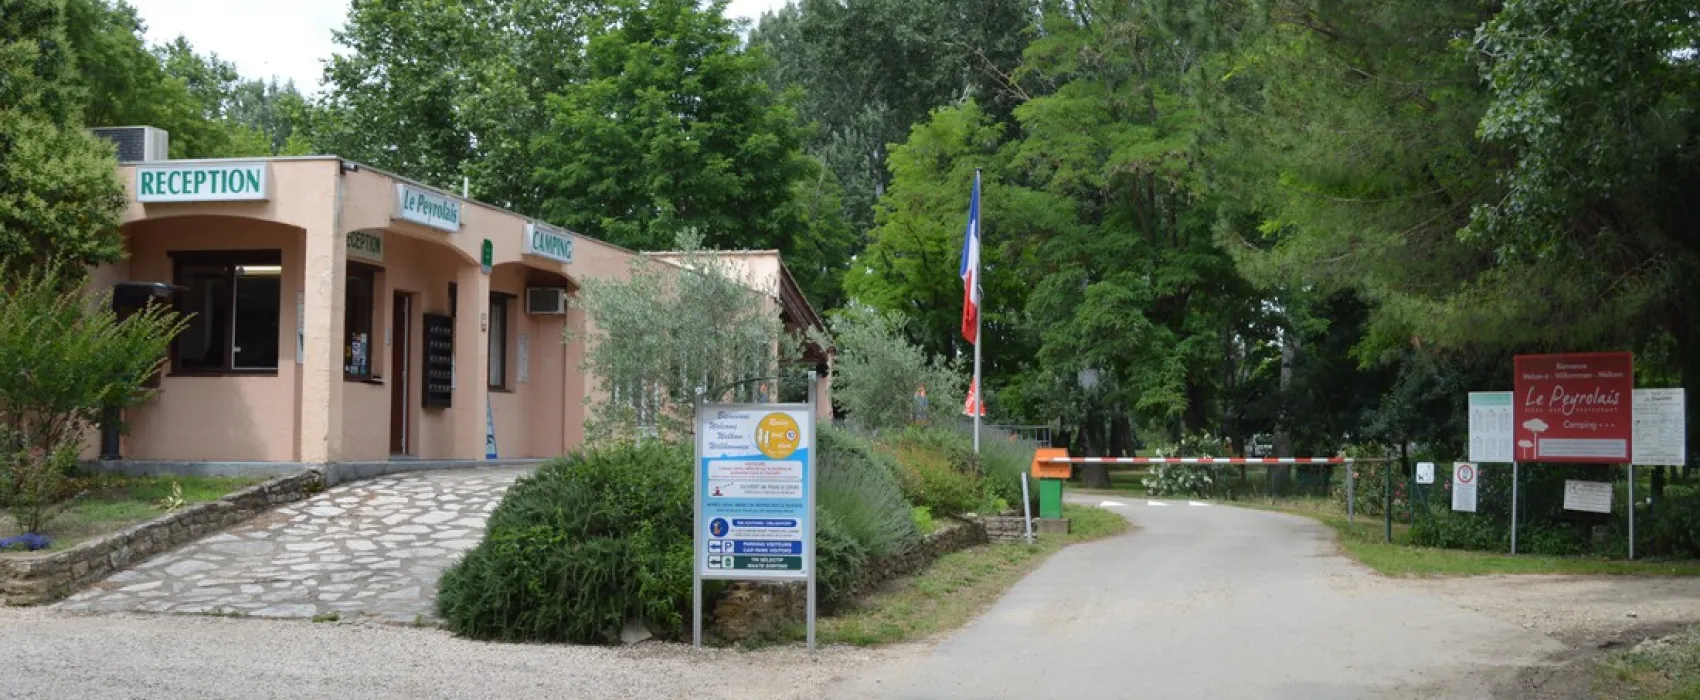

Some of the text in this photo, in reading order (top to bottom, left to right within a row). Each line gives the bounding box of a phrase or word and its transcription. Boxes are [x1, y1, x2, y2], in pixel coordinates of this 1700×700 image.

[141, 169, 261, 195] RECEPTION
[404, 189, 457, 223] Le Peyrolais
[346, 231, 381, 254] ECEPTION
[532, 231, 572, 258] CAMPING
[1525, 384, 1620, 416] Le Peyrolais
[1563, 420, 1597, 430] Camping
